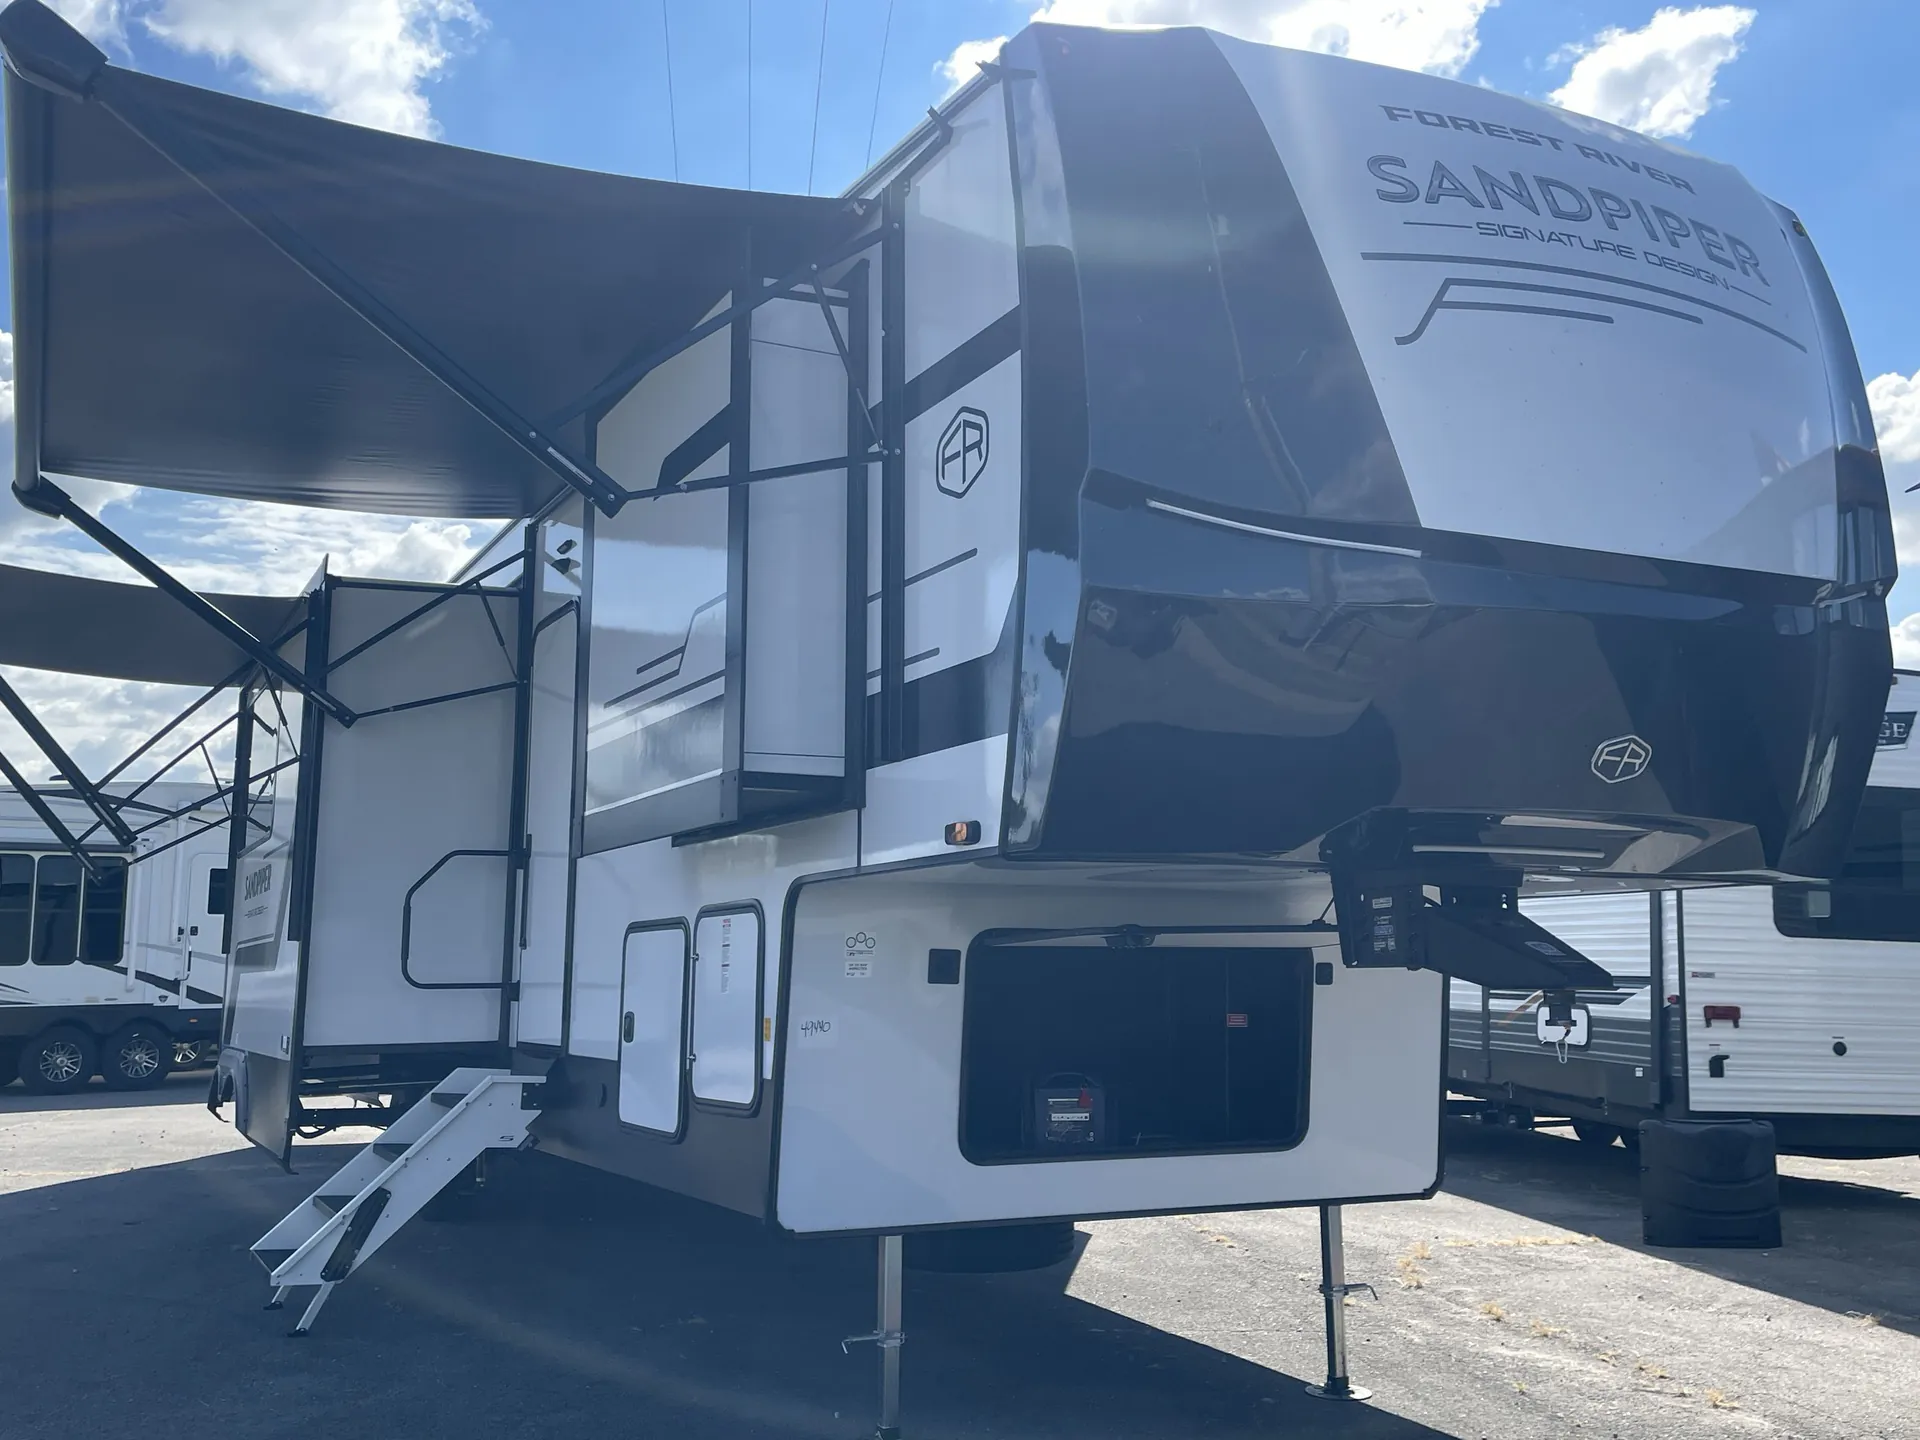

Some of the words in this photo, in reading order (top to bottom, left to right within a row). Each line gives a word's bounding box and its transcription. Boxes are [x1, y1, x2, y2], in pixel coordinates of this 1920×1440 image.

[1380, 105, 1565, 152] FOREST
[1573, 142, 1697, 195] RIVER
[1366, 154, 1771, 287] SANDPIPER
[1475, 221, 1637, 260] SIGNATURE
[1644, 249, 1730, 290] DESIGN
